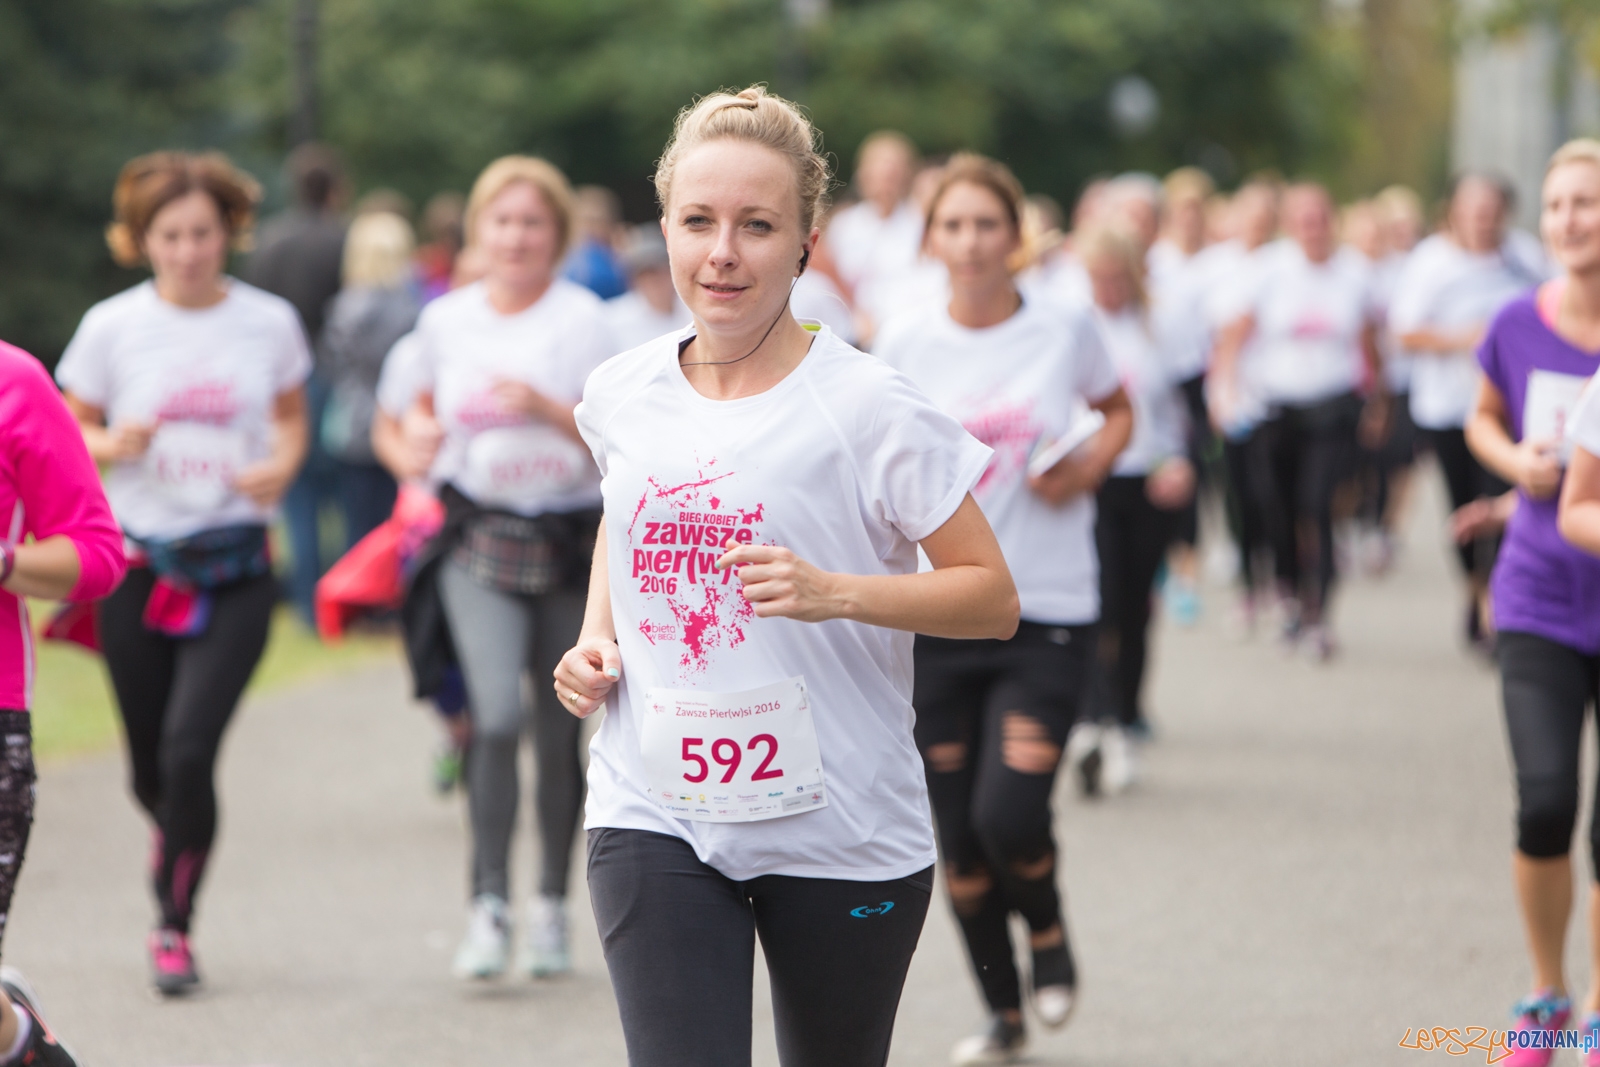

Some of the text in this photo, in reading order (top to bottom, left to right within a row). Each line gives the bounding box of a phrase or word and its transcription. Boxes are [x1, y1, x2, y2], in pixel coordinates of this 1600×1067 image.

[679, 511, 739, 526] BIEG KOBIET
[642, 522, 752, 549] zawsze
[639, 575, 678, 596] 2016
[675, 706, 708, 718] Zawsze
[709, 705, 752, 720] Pier(w)si
[754, 700, 781, 715] 2016
[681, 733, 784, 784] 592
